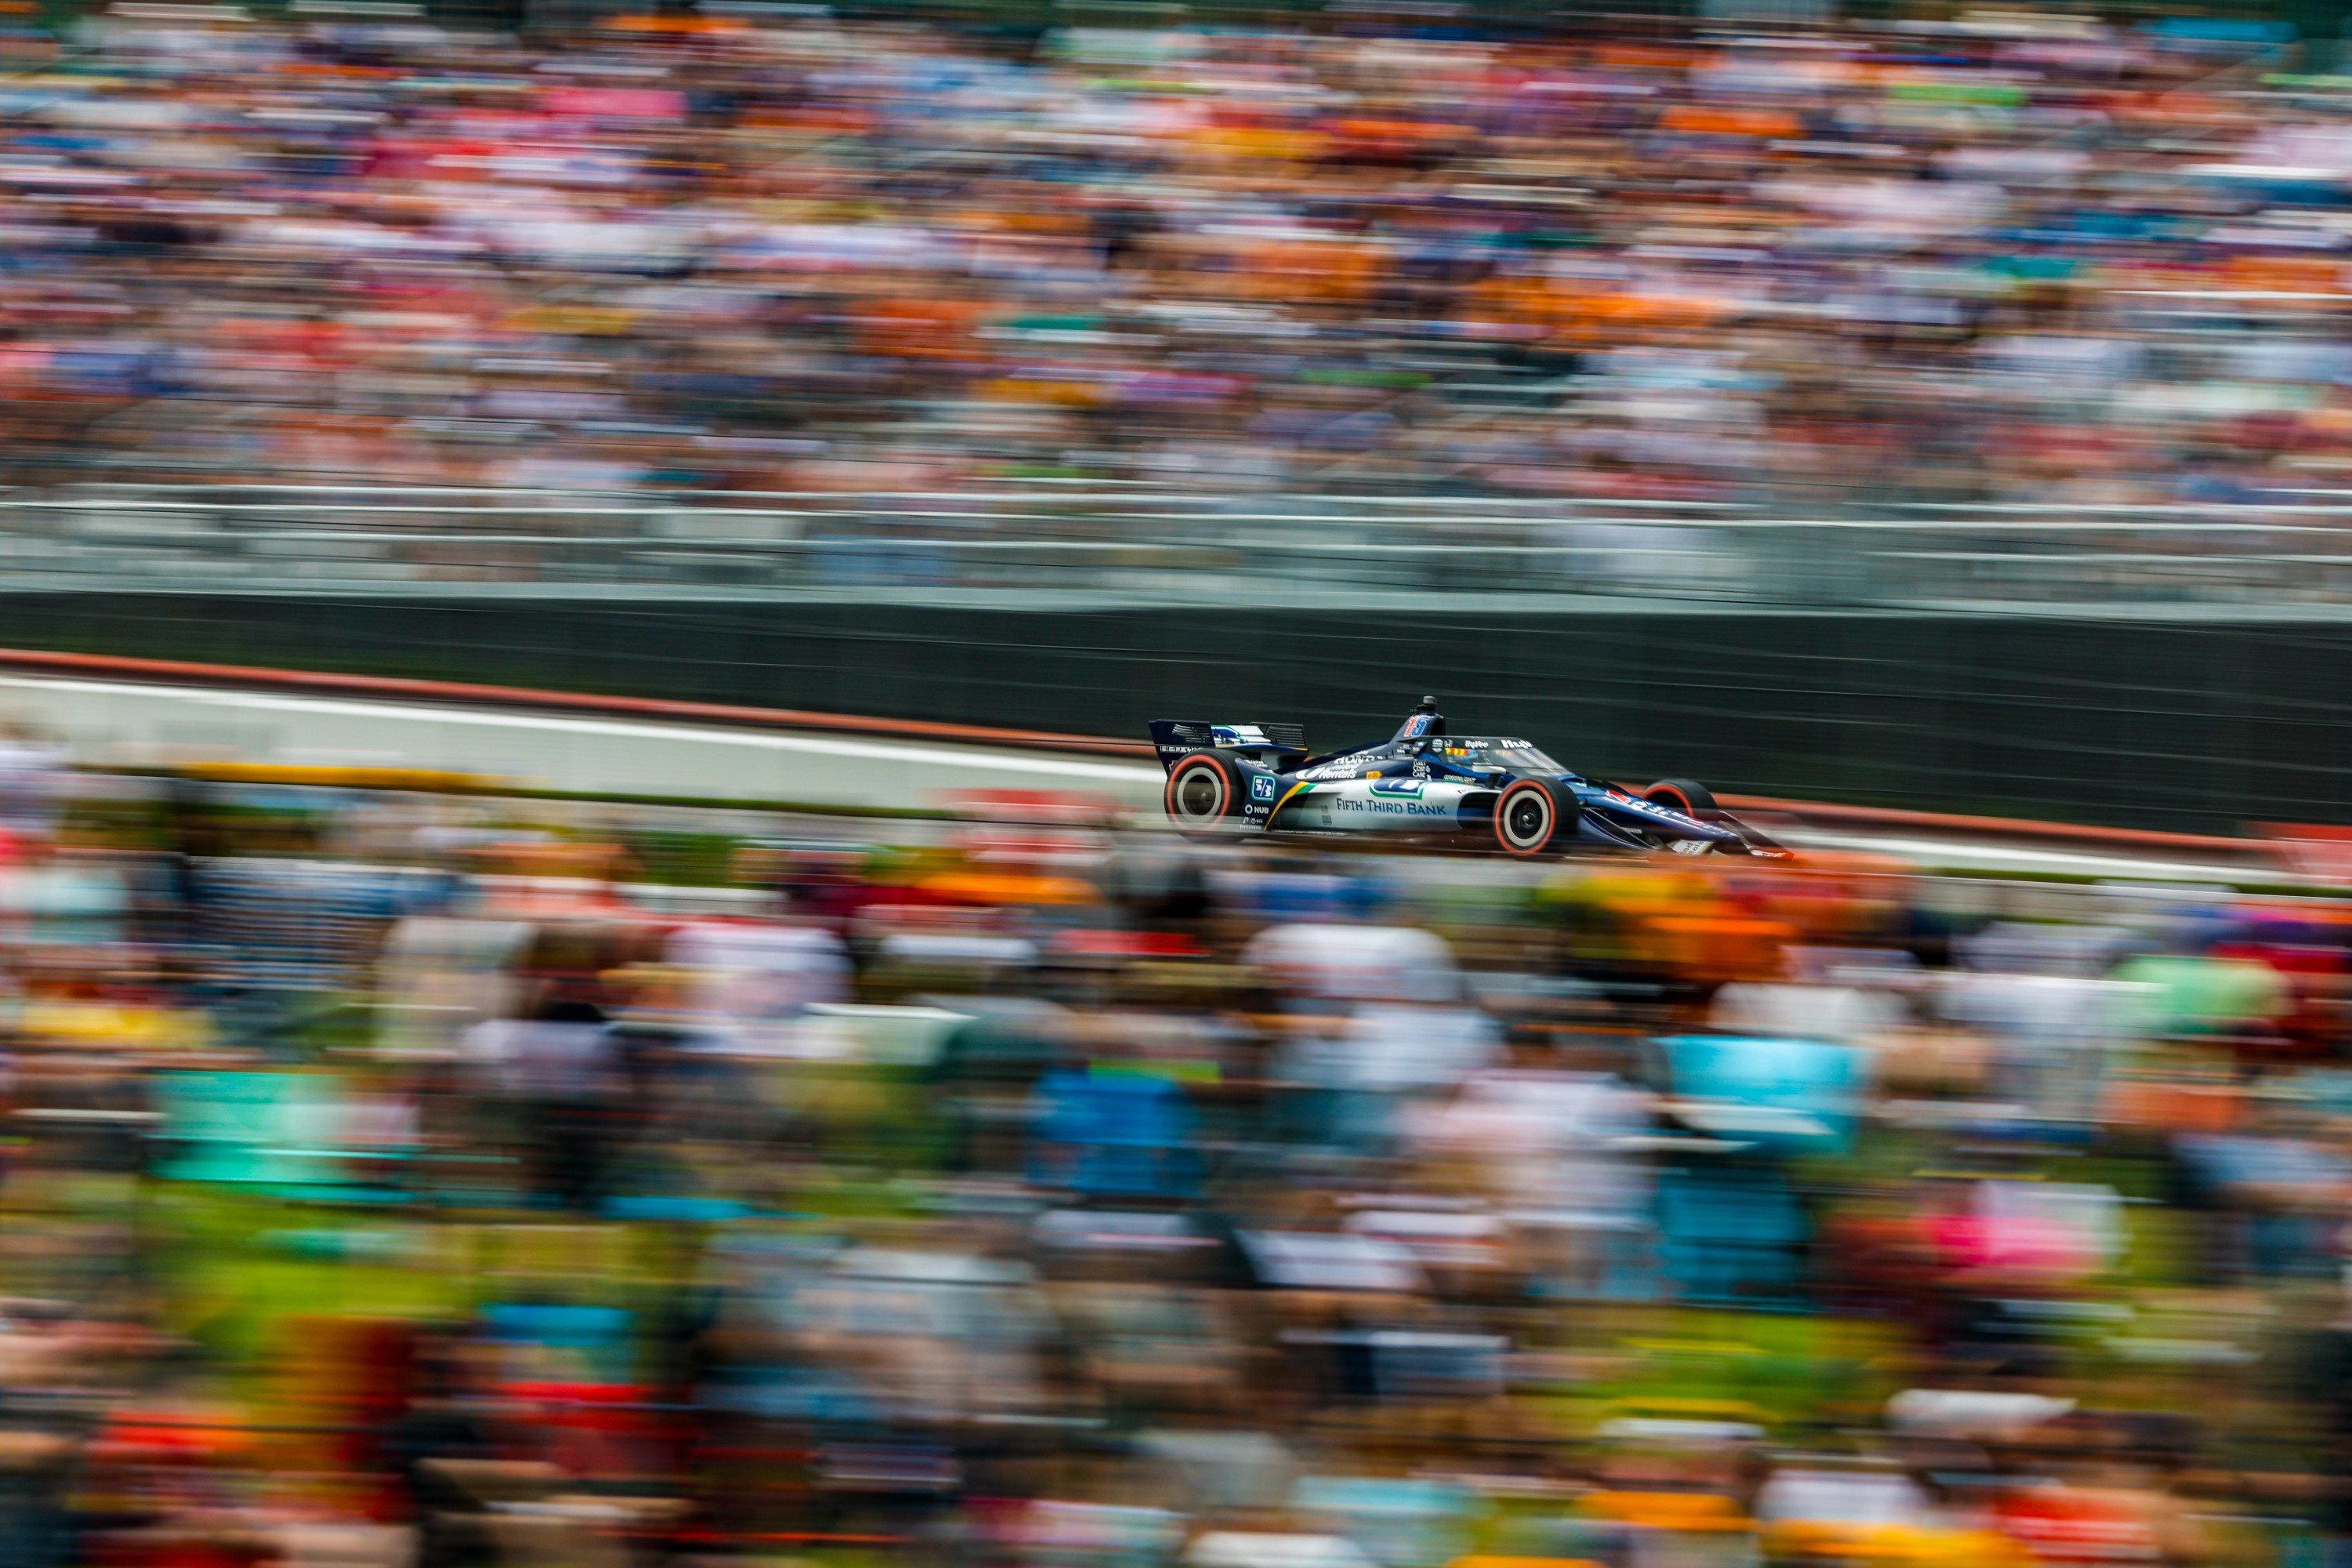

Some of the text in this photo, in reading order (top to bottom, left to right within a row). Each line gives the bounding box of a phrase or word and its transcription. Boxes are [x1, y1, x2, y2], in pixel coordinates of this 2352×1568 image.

[1336, 798, 1447, 815] FIFTH THIRD BANK
